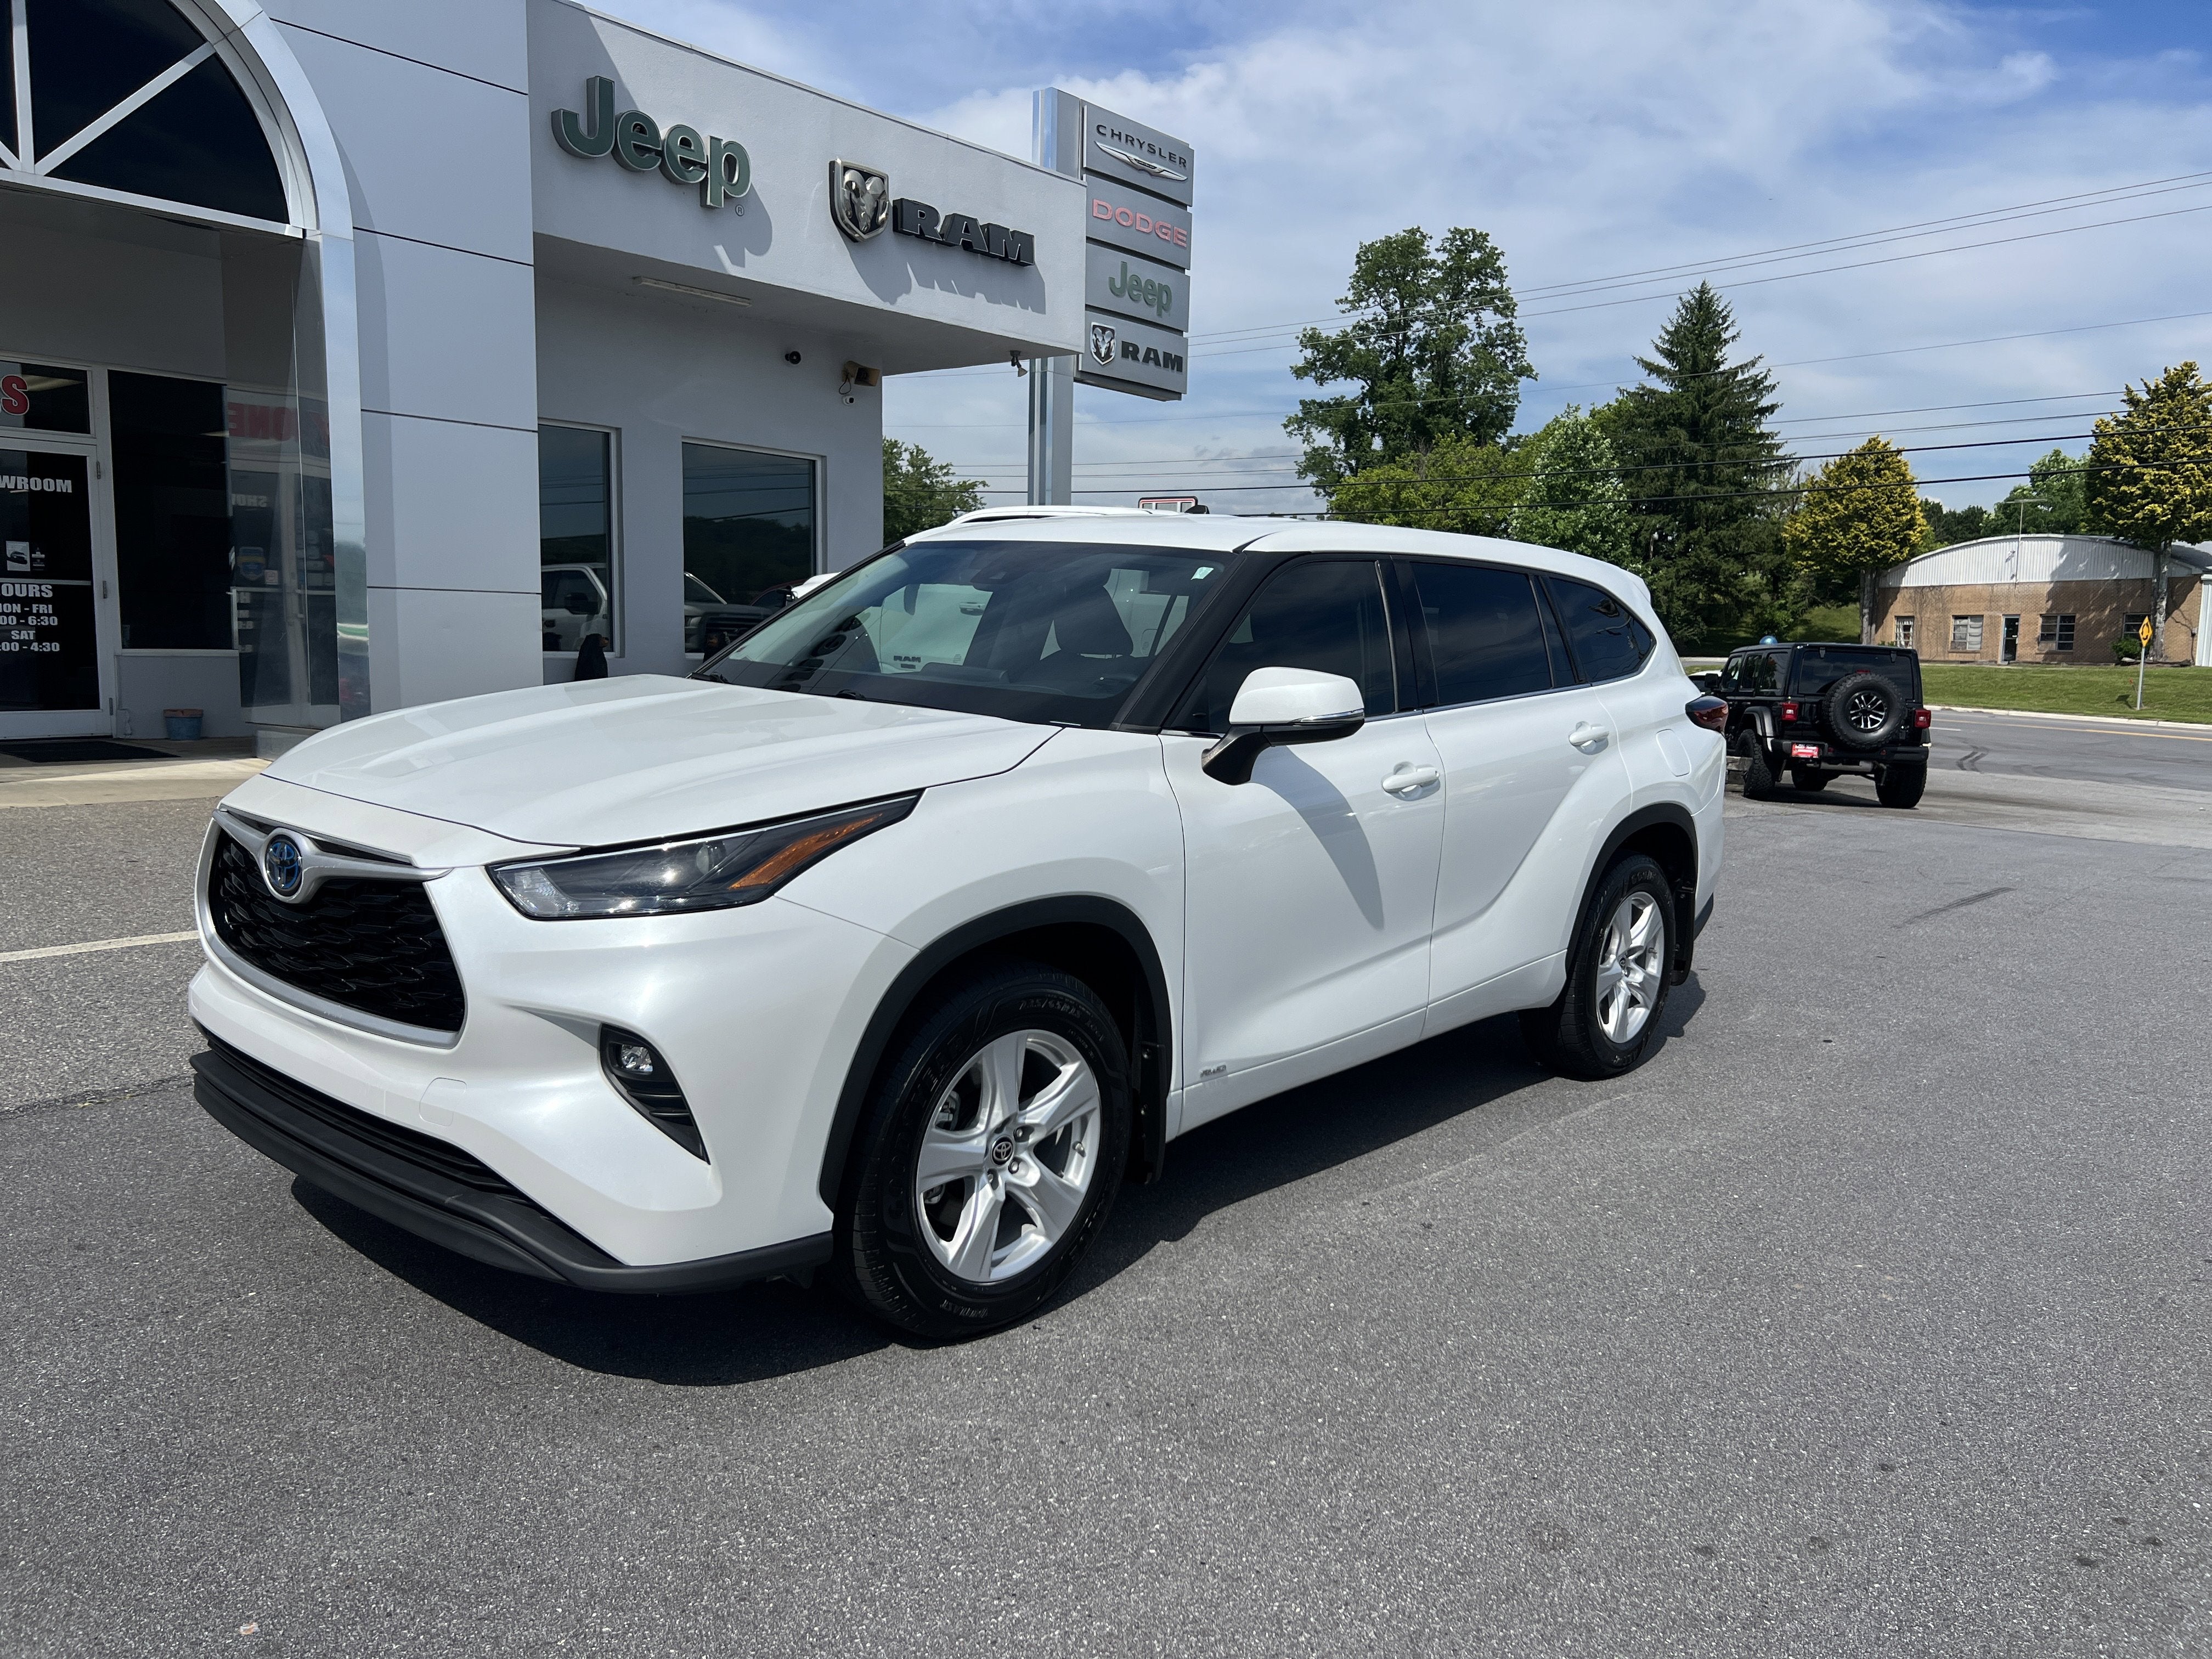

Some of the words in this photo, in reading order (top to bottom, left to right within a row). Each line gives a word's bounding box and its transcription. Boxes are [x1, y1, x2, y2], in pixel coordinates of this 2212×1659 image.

[551, 76, 751, 208] Jeep
[1096, 124, 1187, 168] CHRYSLER
[893, 198, 1035, 266] RAM
[1092, 199, 1188, 248] DODGE
[1109, 261, 1172, 316] Jeep
[1121, 340, 1183, 373] RAM
[0, 374, 30, 415] S
[0, 475, 72, 493] WROOM
[0, 583, 53, 597] OURS
[0, 603, 21, 613] ON
[32, 604, 53, 613] FRI
[28, 616, 58, 625] 6:30
[11, 630, 36, 640] SAT
[30, 642, 60, 652] 4:30
